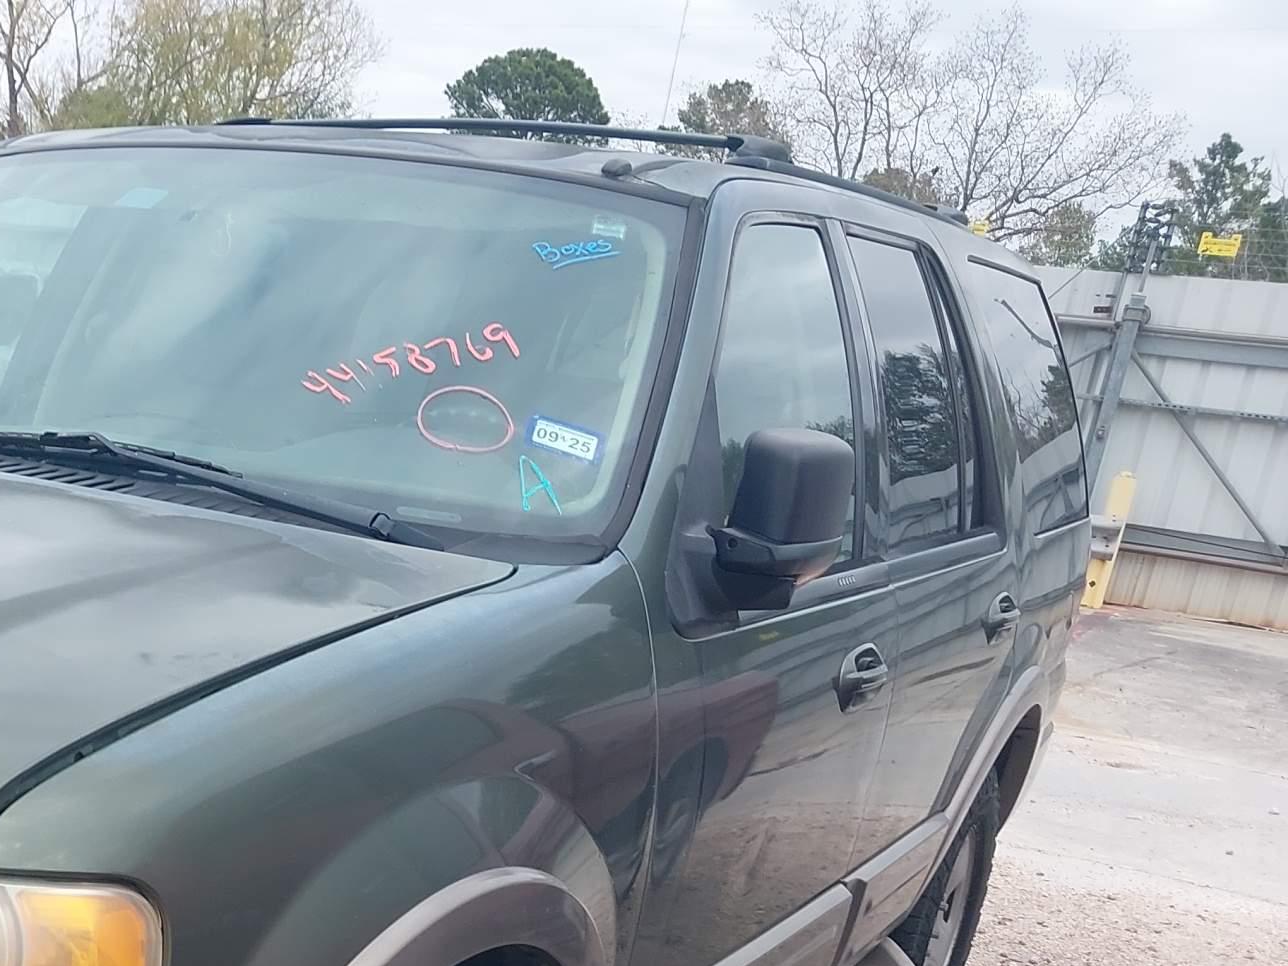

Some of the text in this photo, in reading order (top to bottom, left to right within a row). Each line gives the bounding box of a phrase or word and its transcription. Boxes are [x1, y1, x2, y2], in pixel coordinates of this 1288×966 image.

[532, 240, 613, 263] Boxes
[300, 322, 520, 404] 44158769
[536, 427, 559, 443] 09
[568, 437, 592, 454] 25
[519, 454, 562, 516] A
